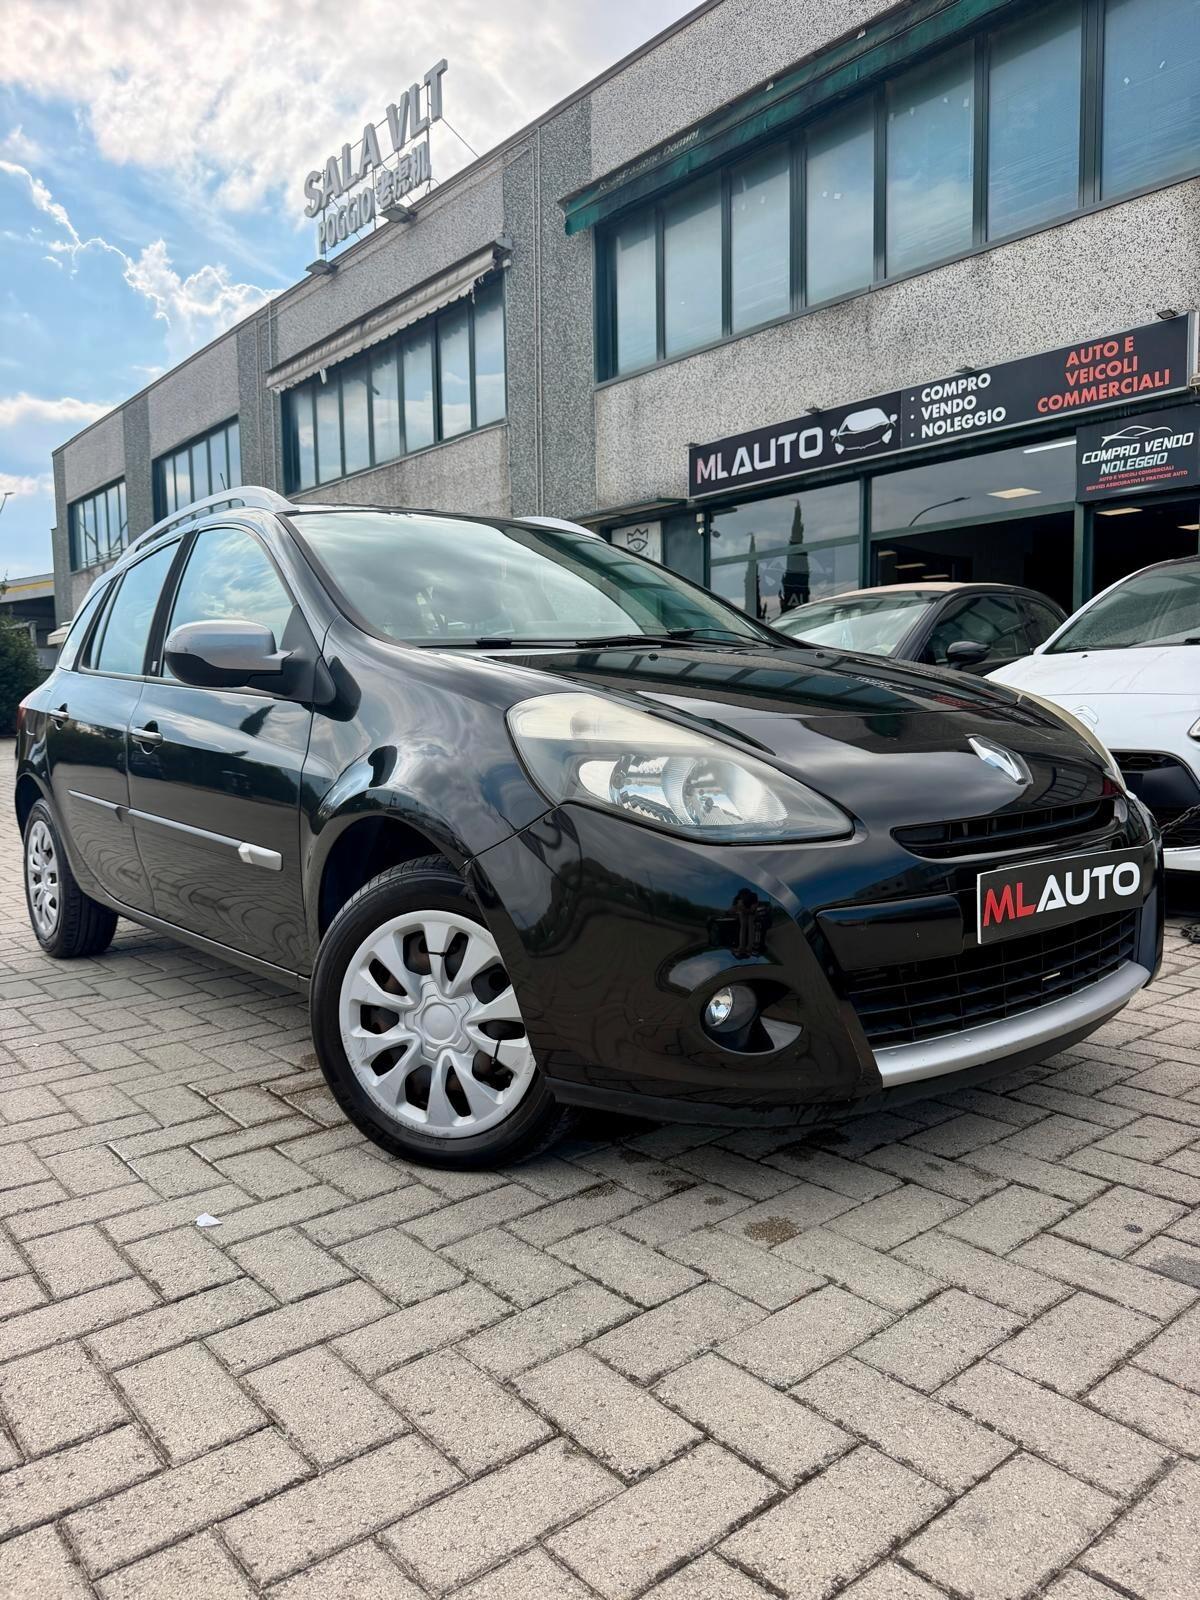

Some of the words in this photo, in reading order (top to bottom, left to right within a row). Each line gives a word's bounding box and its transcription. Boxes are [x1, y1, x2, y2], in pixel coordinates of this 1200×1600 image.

[304, 122, 382, 218] SALA
[385, 58, 448, 152] VLT
[318, 187, 375, 254] POGGIO
[1065, 341, 1119, 368] AUTO
[1124, 336, 1134, 353] E
[1065, 355, 1138, 386] VEICOLI
[921, 373, 991, 402] COMPRO
[1037, 369, 1170, 413] COMMERCIALI
[921, 395, 977, 420] VENDO
[921, 406, 1007, 438] NOLEGGIO
[1082, 443, 1140, 464] COMPRO
[1144, 432, 1194, 453] VENDO
[1100, 452, 1168, 475] NOLEGGIO
